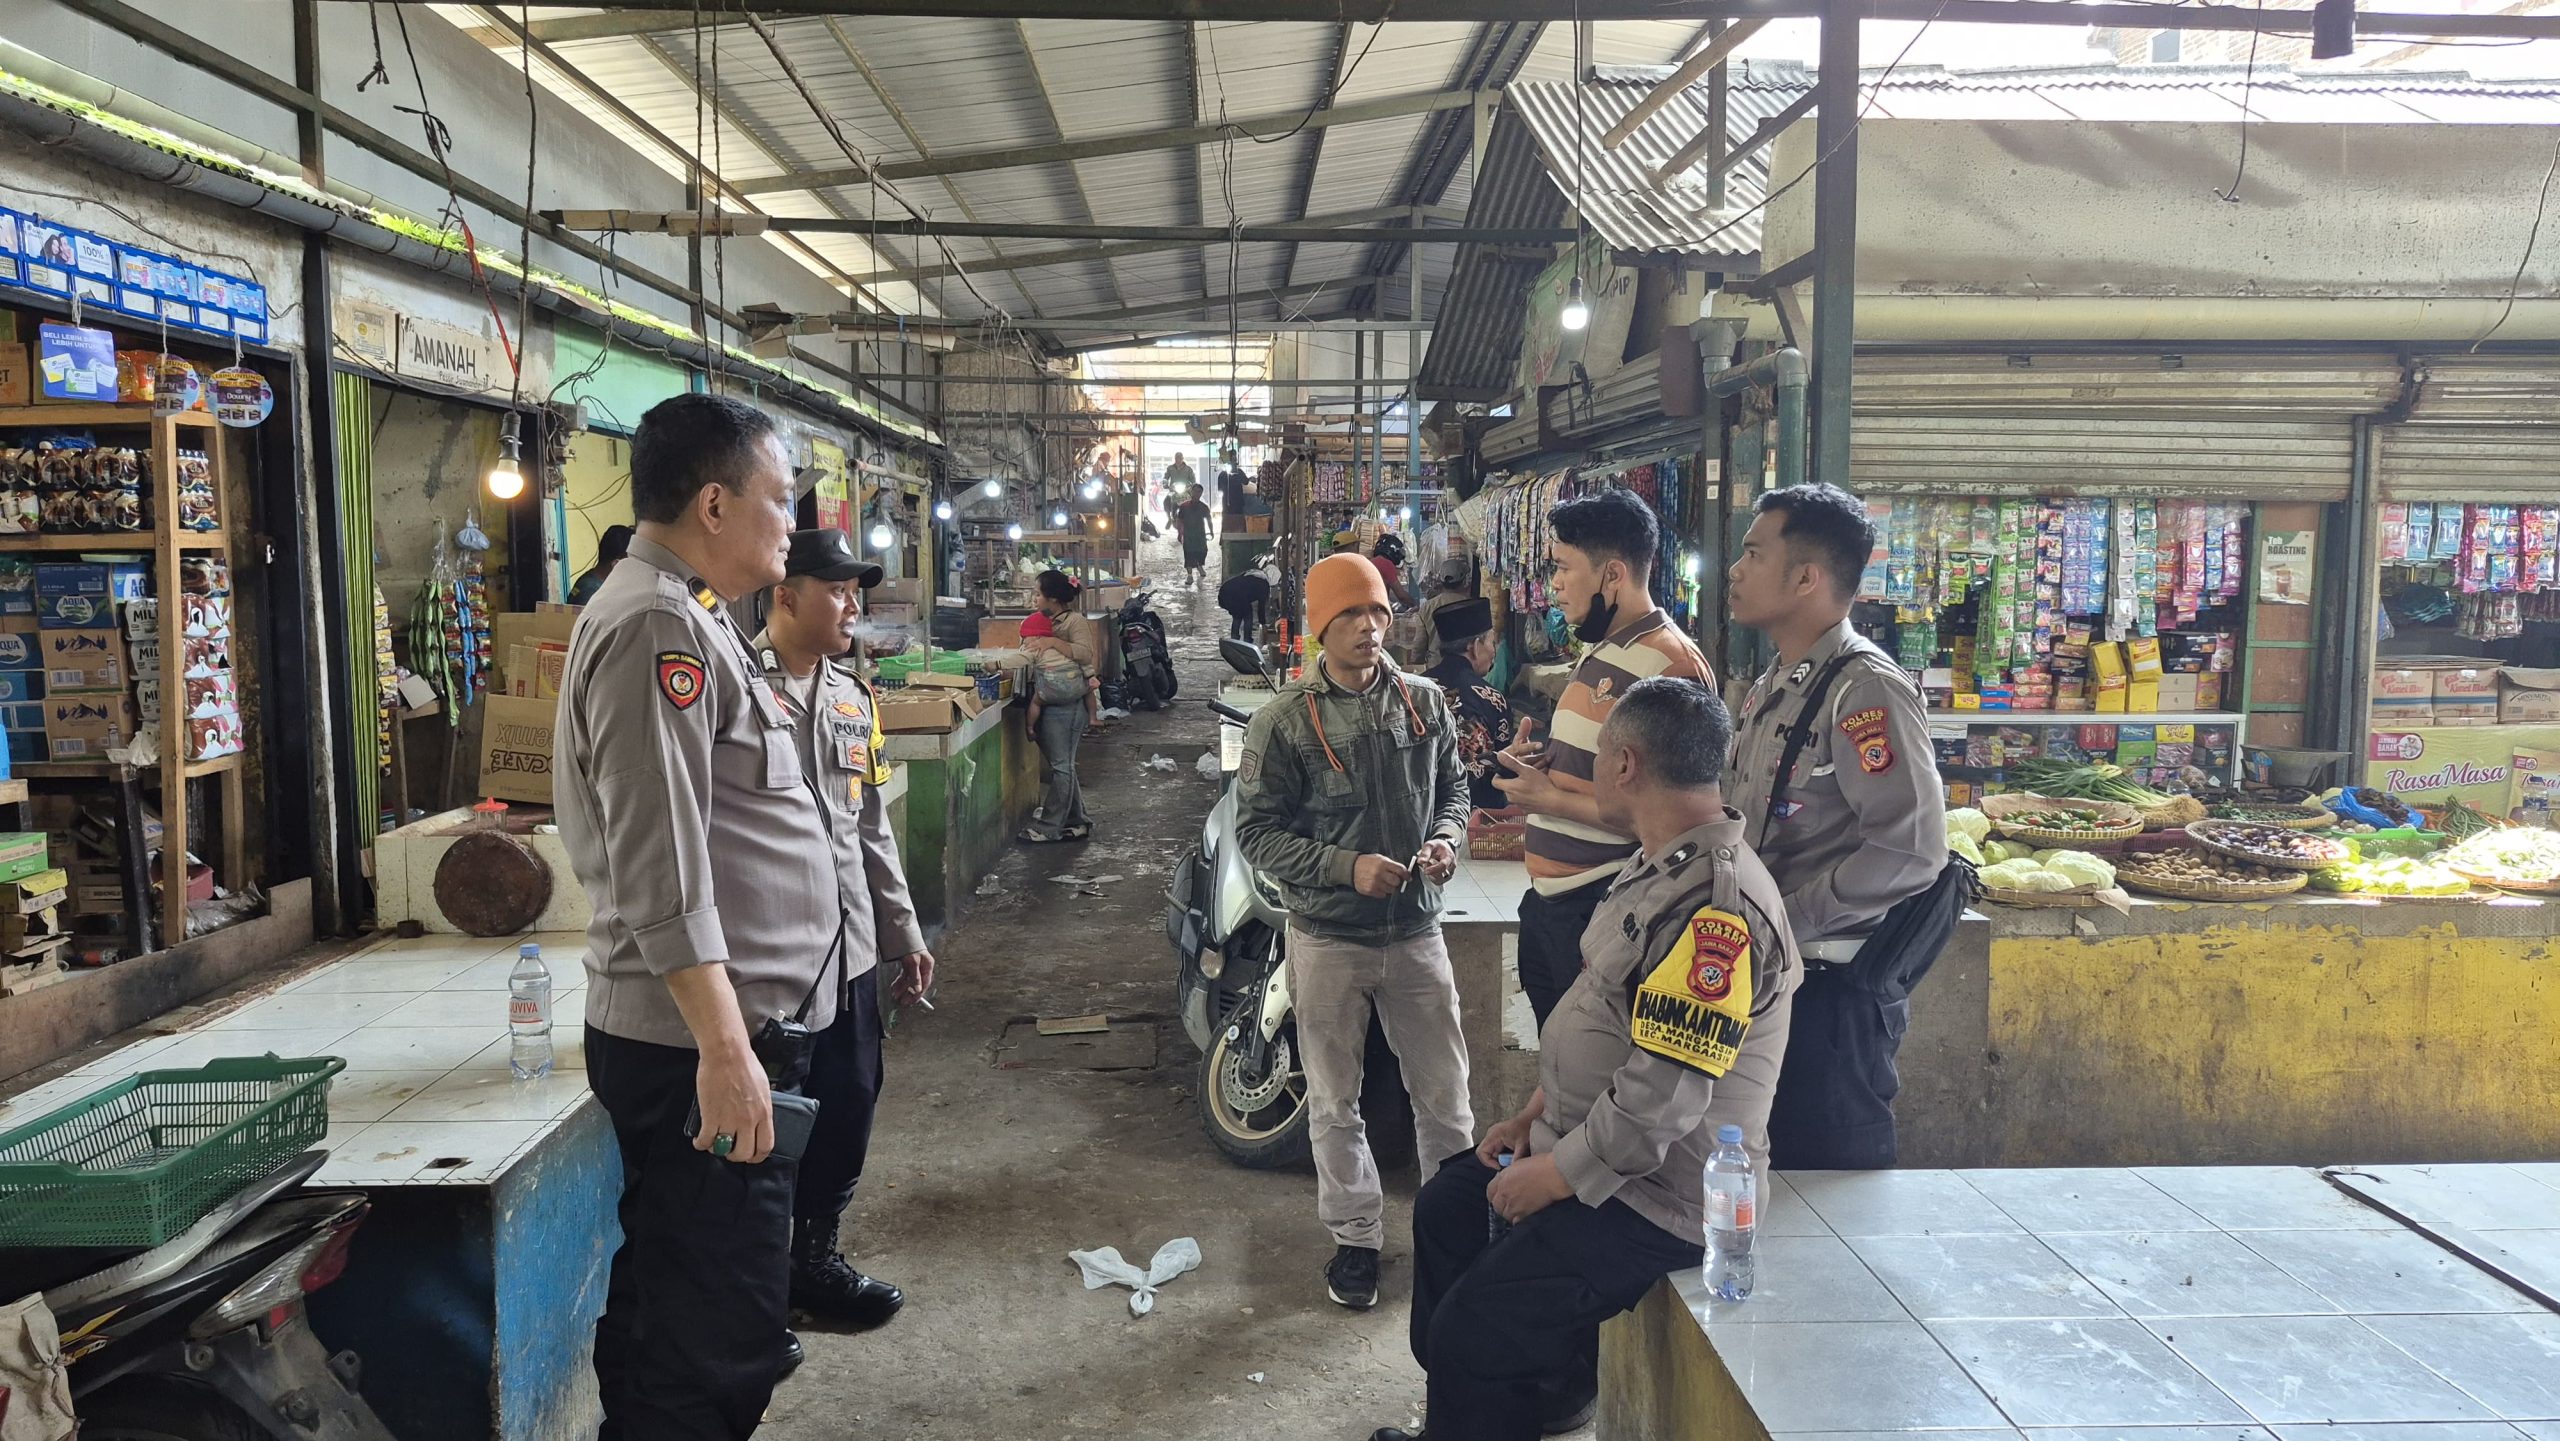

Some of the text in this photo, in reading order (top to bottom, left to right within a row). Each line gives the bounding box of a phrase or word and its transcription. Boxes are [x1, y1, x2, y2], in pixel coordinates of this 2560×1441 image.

[413, 333, 477, 377] AMANAH
[2267, 546, 2307, 555] ROASTING
[130, 577, 147, 598] AQ
[62, 597, 85, 607] AQUA
[0, 638, 20, 652] QUA
[1841, 709, 1884, 730] POLRES
[1774, 722, 1819, 749] PORI
[1696, 920, 1747, 943] POLRES
[510, 1002, 538, 1014] UVIVA
